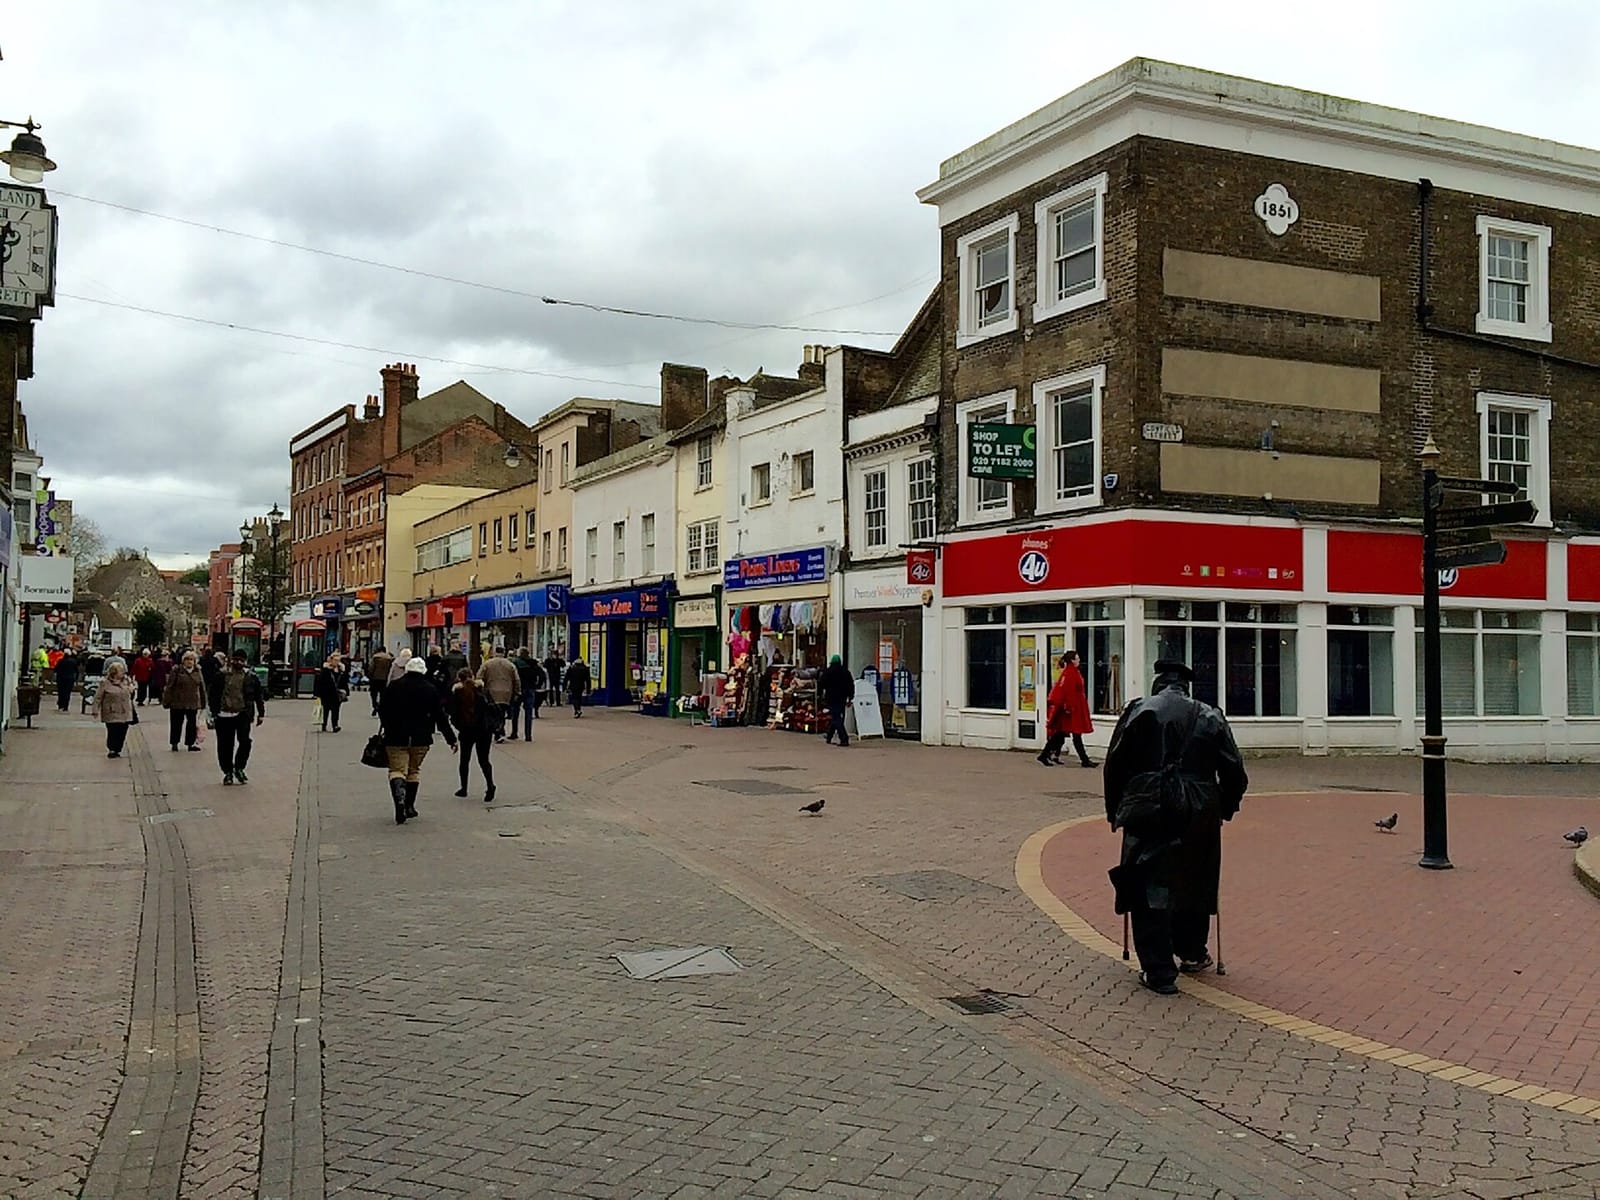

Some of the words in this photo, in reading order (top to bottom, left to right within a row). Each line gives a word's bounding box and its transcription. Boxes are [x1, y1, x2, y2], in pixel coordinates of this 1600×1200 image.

[1262, 201, 1291, 218] 1851
[972, 430, 999, 442] SHOP
[972, 442, 992, 456] TO
[995, 444, 1022, 457] LET
[972, 456, 989, 466] 020
[1012, 458, 1034, 468] 2000
[1438, 567, 1456, 586] u
[493, 591, 530, 618] WHSmith
[548, 591, 561, 610] S
[593, 602, 612, 618] Shoe
[612, 600, 632, 616] Zone
[640, 604, 658, 613] Zone
